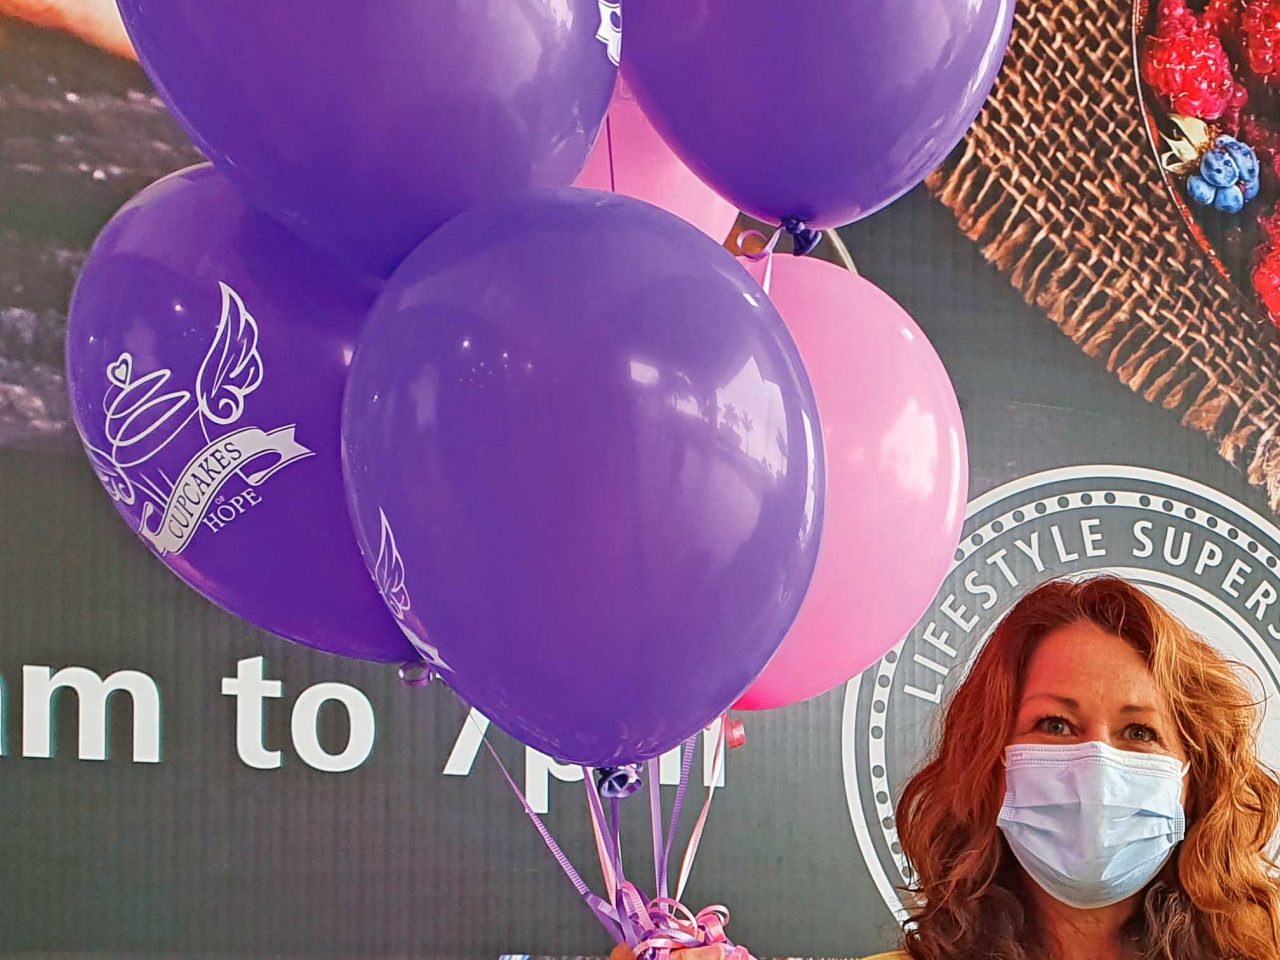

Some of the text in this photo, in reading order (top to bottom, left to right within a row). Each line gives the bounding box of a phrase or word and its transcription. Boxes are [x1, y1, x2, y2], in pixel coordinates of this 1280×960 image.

[168, 442, 242, 539] CUPCAKES
[202, 488, 262, 533] HOPE
[903, 519, 1106, 704] LIFESTYLE
[0, 663, 162, 763] m
[221, 655, 376, 773] to
